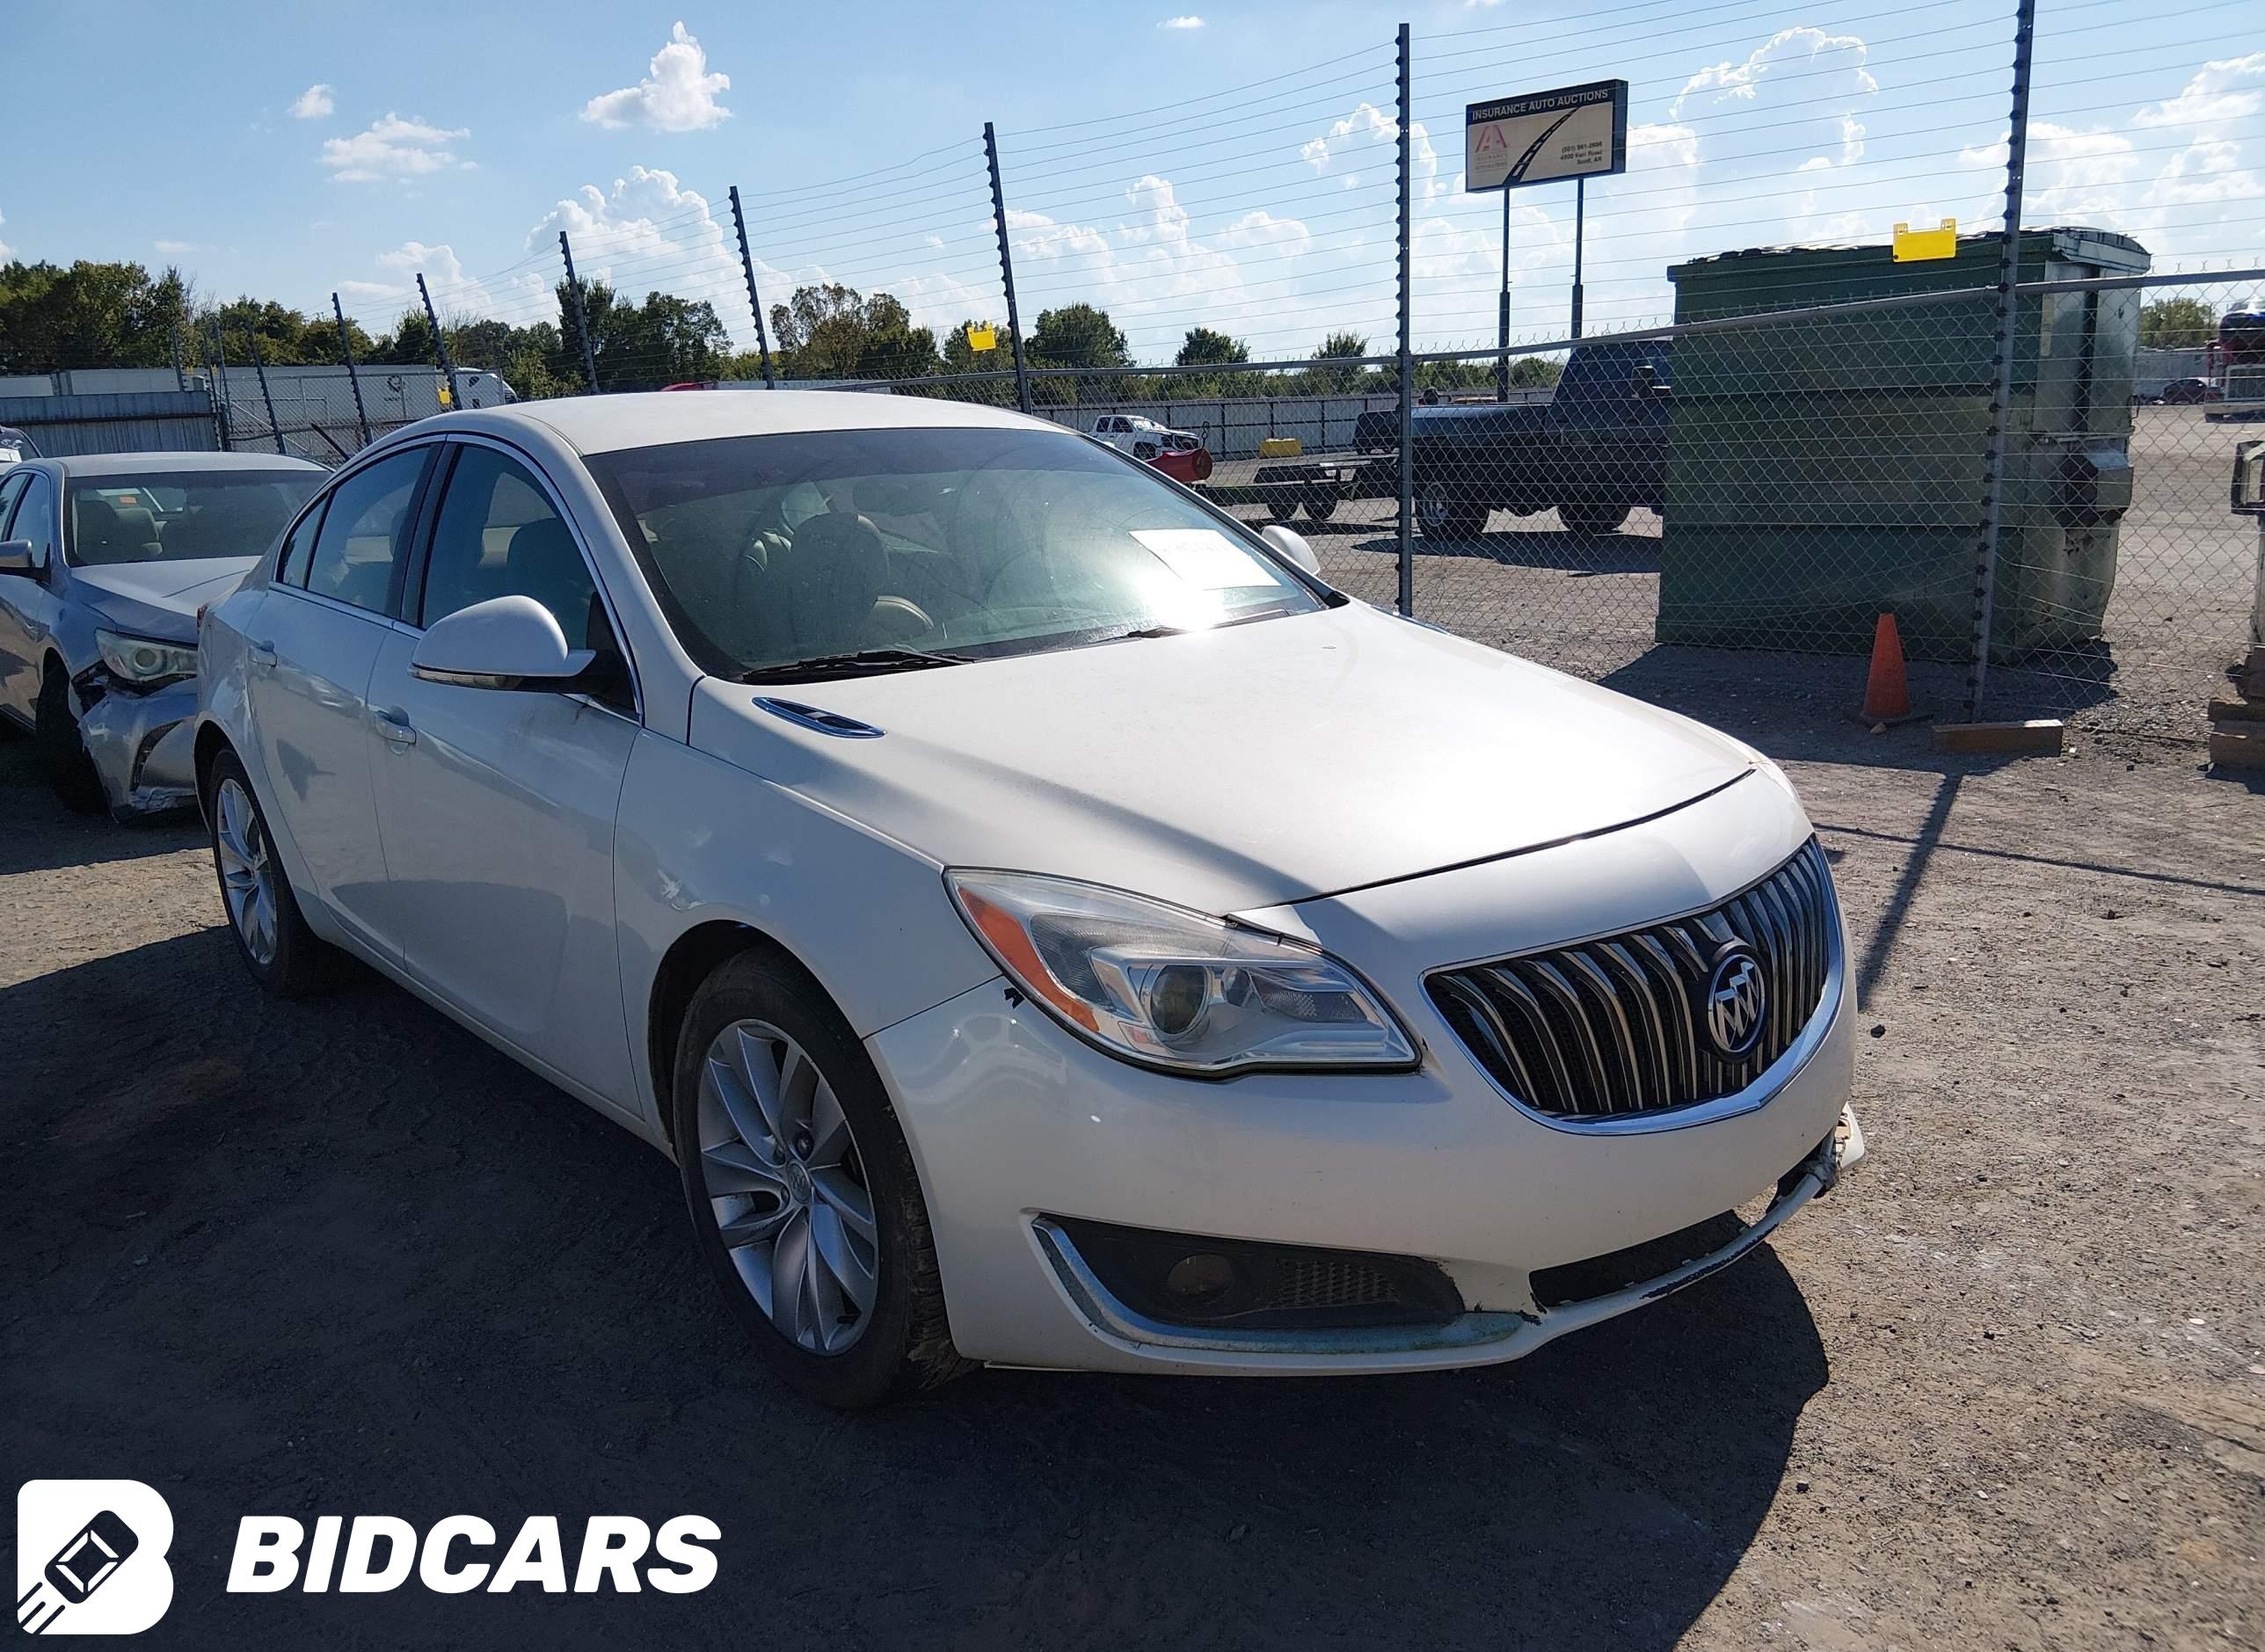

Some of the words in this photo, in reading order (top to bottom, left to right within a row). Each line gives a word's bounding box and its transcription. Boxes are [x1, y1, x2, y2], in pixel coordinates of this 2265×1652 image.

[1472, 103, 1527, 120] INSURANCE
[1528, 98, 1555, 110] AUTO
[1557, 89, 1608, 106] AUCTIONS
